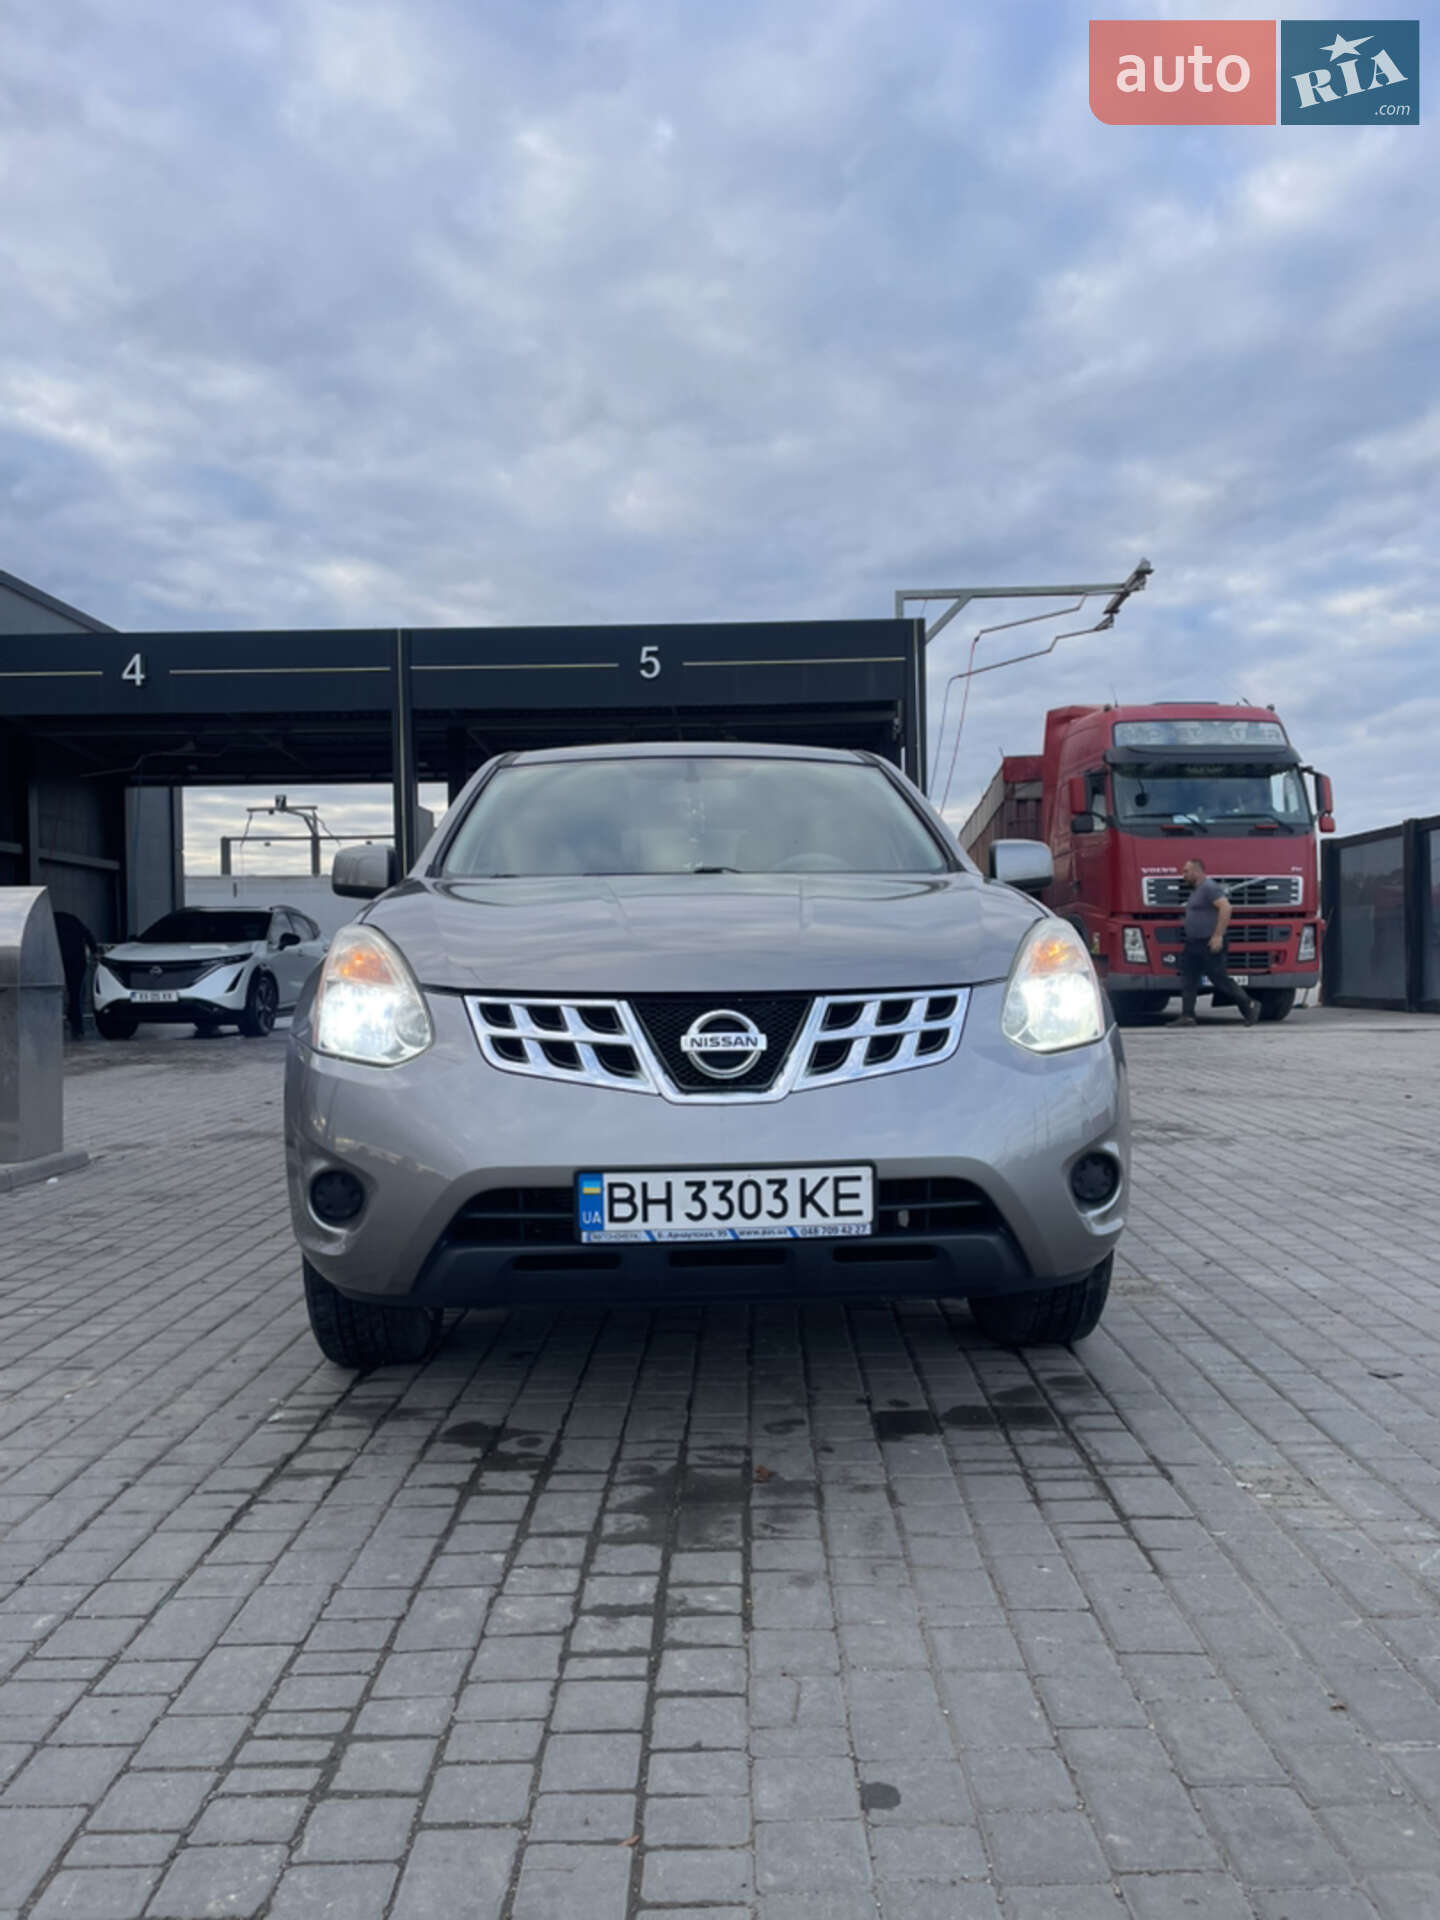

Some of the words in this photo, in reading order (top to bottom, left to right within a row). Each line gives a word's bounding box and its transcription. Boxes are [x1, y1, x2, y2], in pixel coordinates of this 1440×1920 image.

[121, 652, 146, 687] 4
[639, 645, 661, 679] 5
[690, 1036, 758, 1048] NISSAN
[607, 1181, 673, 1224] BH
[684, 1178, 789, 1222] 3303
[799, 1175, 864, 1219] KE
[581, 1211, 602, 1225] UA
